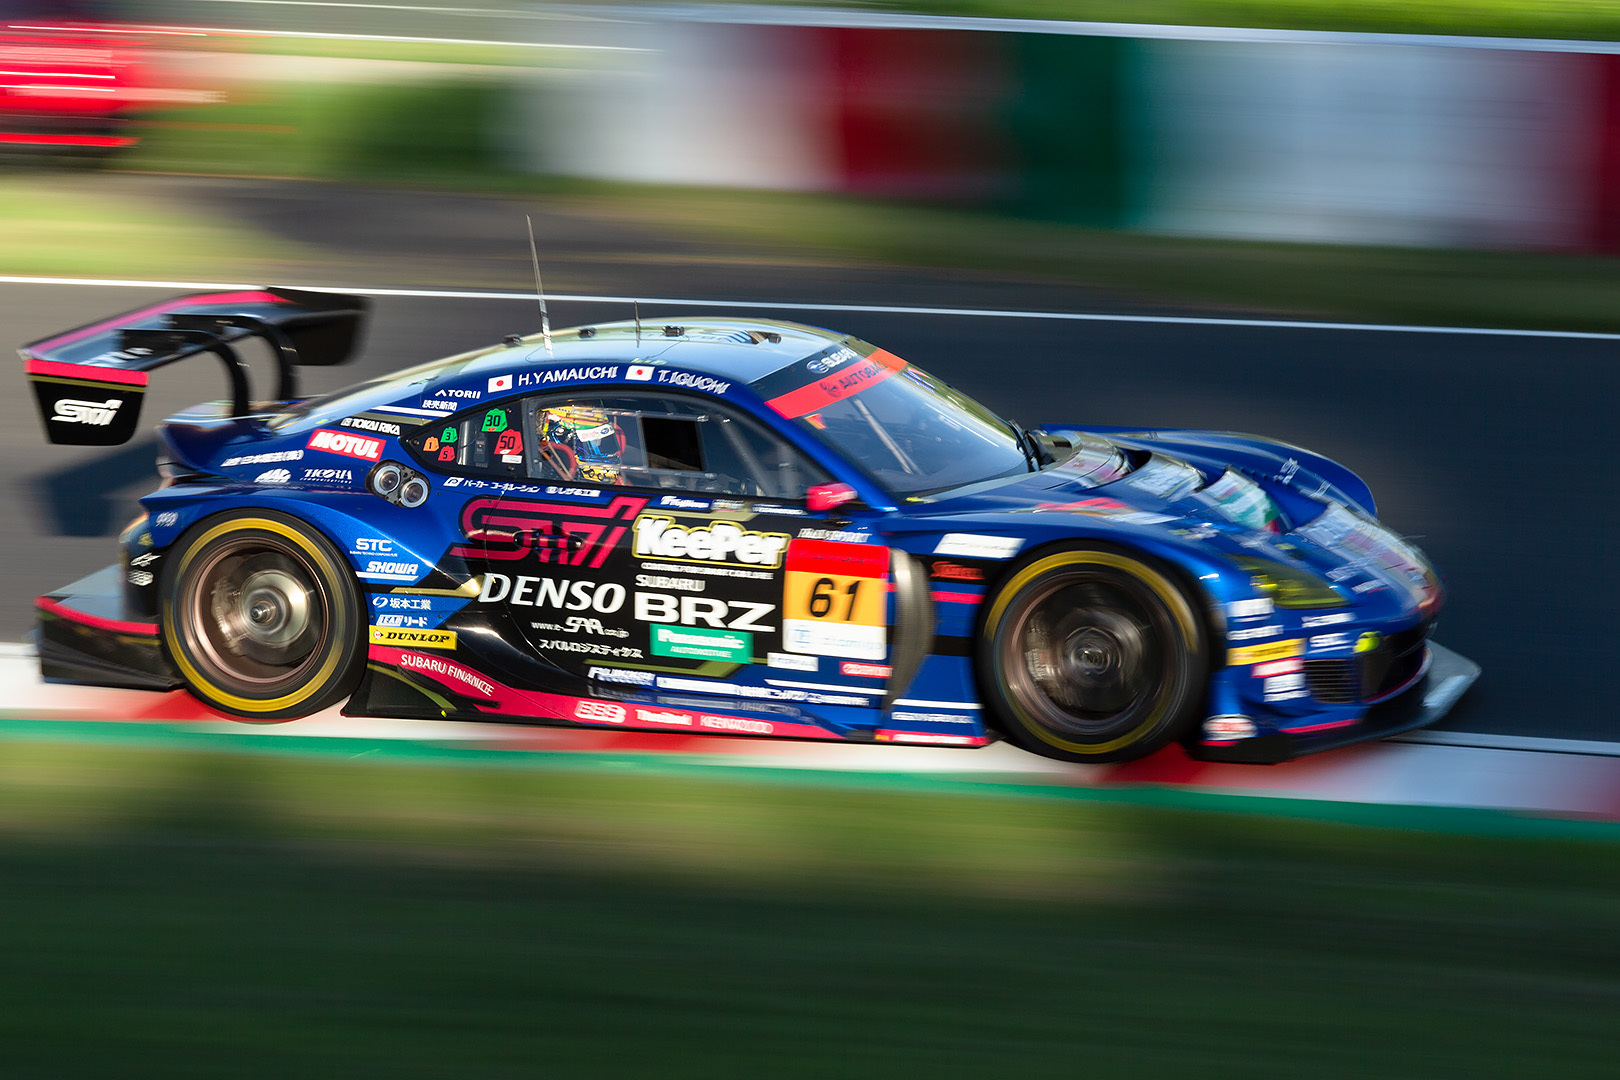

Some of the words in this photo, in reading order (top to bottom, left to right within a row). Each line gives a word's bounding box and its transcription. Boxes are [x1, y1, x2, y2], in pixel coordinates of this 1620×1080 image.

[518, 366, 618, 386] H.YAMAUCHI
[658, 369, 730, 394] T.IGUCHI
[351, 418, 379, 431] TOKAI
[378, 421, 400, 435] RIKA
[486, 414, 501, 427] 30
[445, 431, 451, 441] 3
[499, 436, 515, 449] 50
[310, 432, 380, 458] MOTUL
[443, 450, 448, 459] 5
[356, 538, 393, 552] STC
[366, 561, 418, 575] SHOWA
[635, 574, 706, 591] SUBARU
[478, 572, 626, 613] DENSO
[809, 578, 862, 621] 61
[389, 597, 431, 610] 坂本工業
[634, 591, 776, 633] BRZ
[404, 616, 428, 627] リード
[386, 632, 450, 643] DUNLOP
[401, 654, 448, 673] SUBARU
[448, 665, 495, 696] FINANCE
